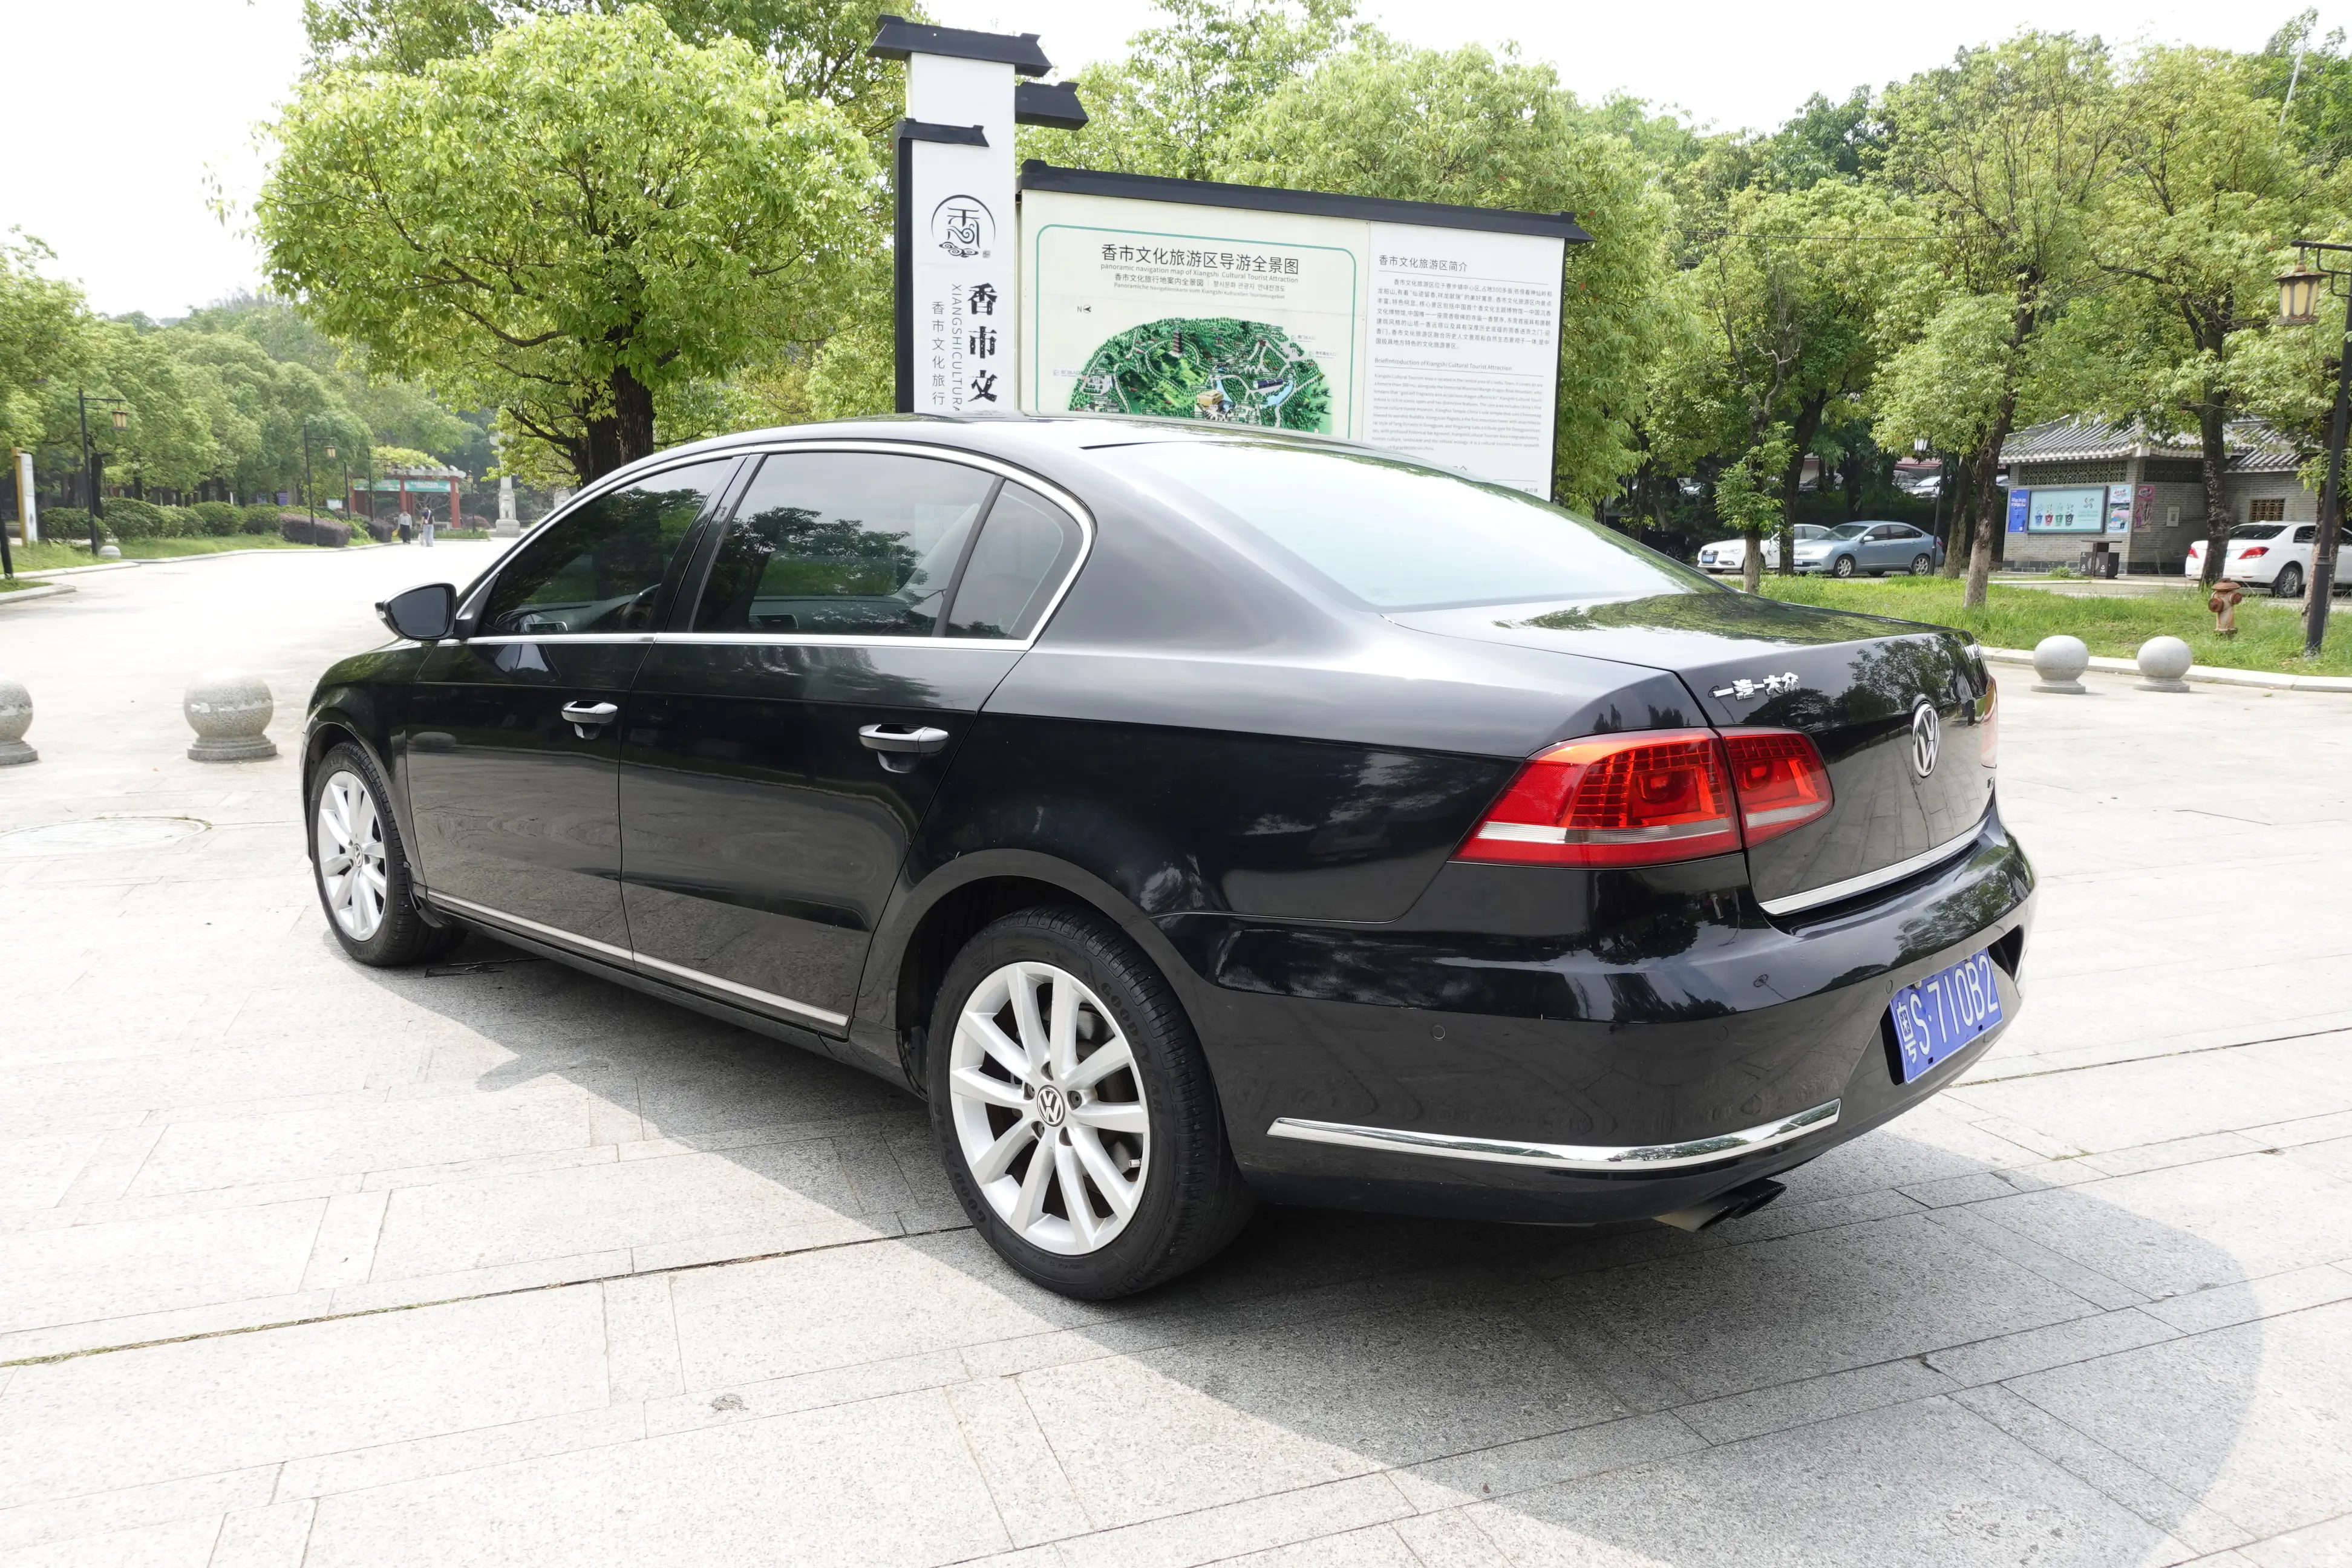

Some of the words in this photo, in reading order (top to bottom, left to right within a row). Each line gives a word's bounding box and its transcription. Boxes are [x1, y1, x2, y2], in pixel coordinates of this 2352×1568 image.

[1102, 244, 1298, 274] 香市文化旅游区导游全景图
[1379, 255, 1468, 272] 香市文化旅游区简介
[1193, 269, 1219, 278] Xiangshi
[1269, 275, 1298, 283] Attraction
